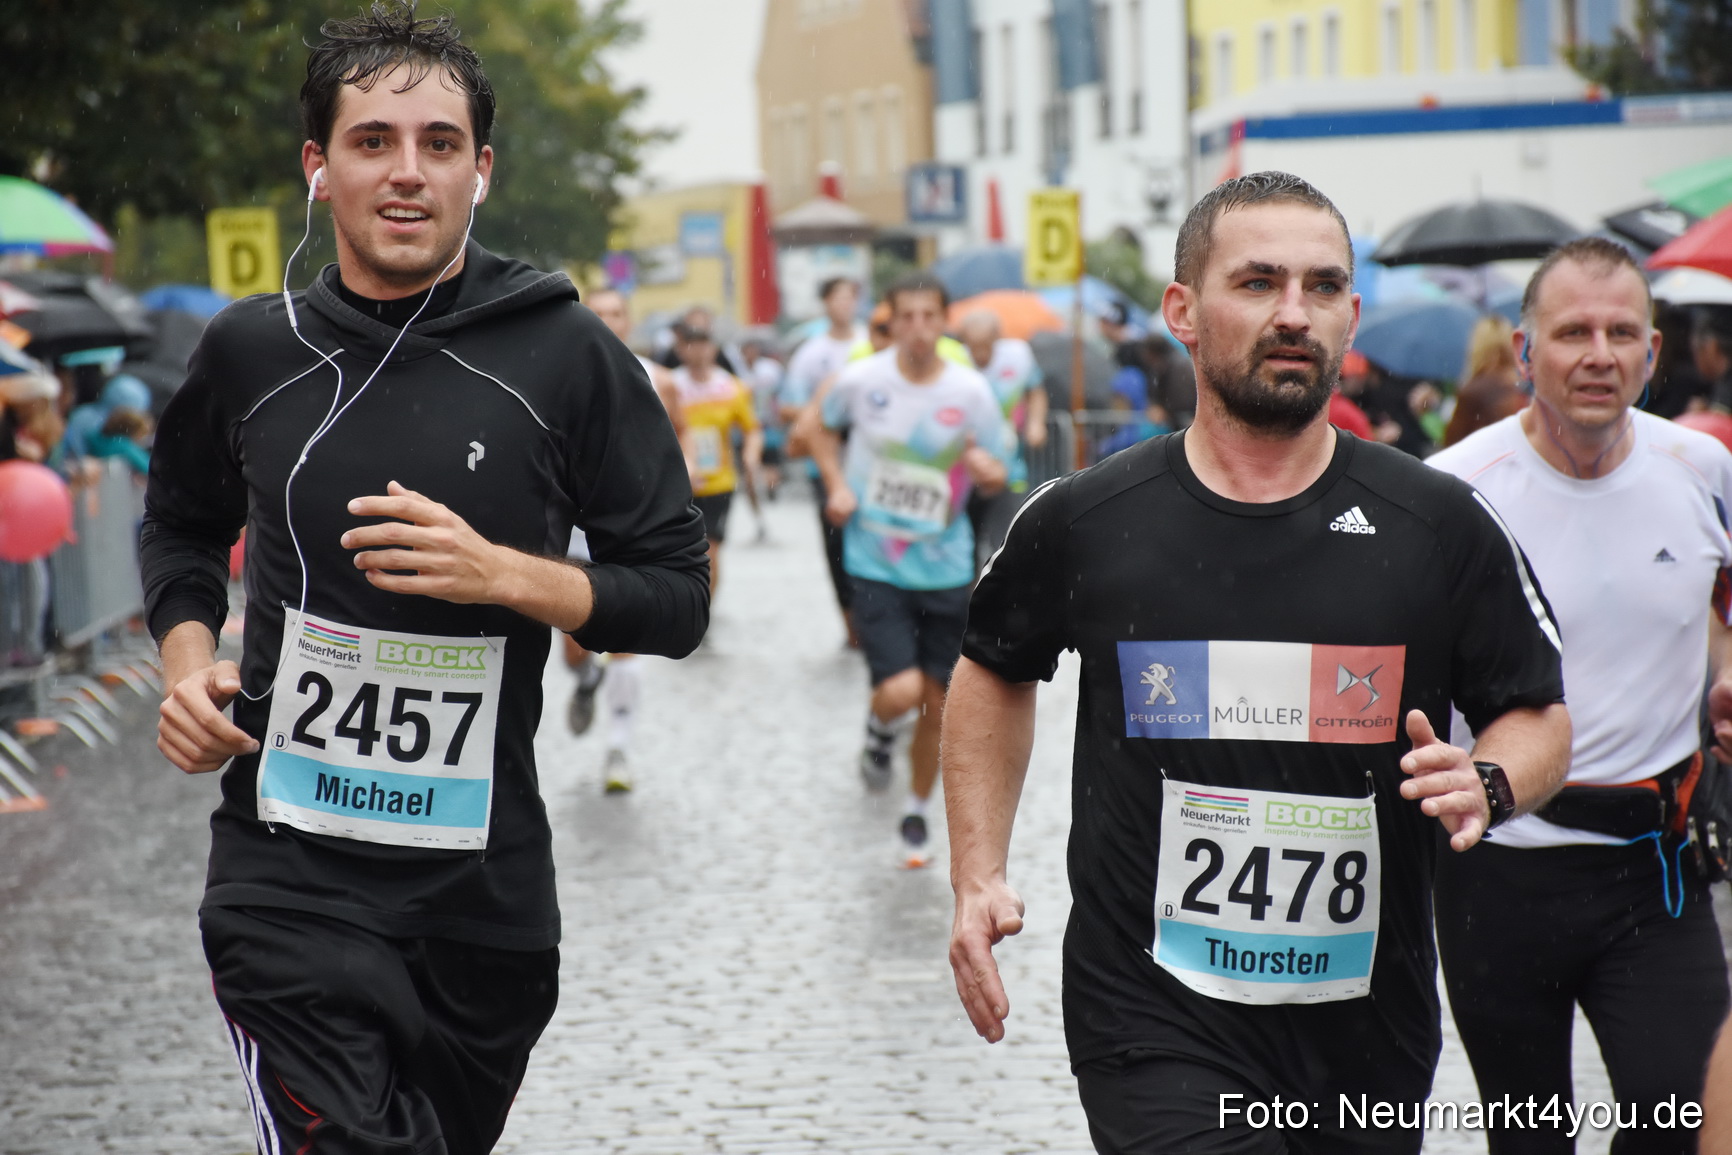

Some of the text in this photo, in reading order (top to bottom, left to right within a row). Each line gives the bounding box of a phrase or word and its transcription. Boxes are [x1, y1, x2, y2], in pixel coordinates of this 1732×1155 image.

[229, 240, 262, 287] D
[1329, 522, 1376, 535] adidas
[298, 637, 362, 664] NeuerMarkt
[376, 639, 487, 670] BOCK
[374, 663, 487, 680] inspired by smart concepts
[291, 670, 483, 766] 2457
[1129, 713, 1204, 724] PEUGEOT
[274, 734, 285, 748] D
[314, 771, 435, 816] Michael
[1180, 807, 1252, 827] NeuerMarkt
[1265, 801, 1372, 831] BOCK
[1264, 827, 1299, 838] inspired
[1300, 829, 1311, 839] by
[1313, 831, 1339, 840] smart
[1180, 838, 1368, 924] 2478
[1164, 904, 1173, 917] D
[1205, 937, 1330, 975] Thorsten
